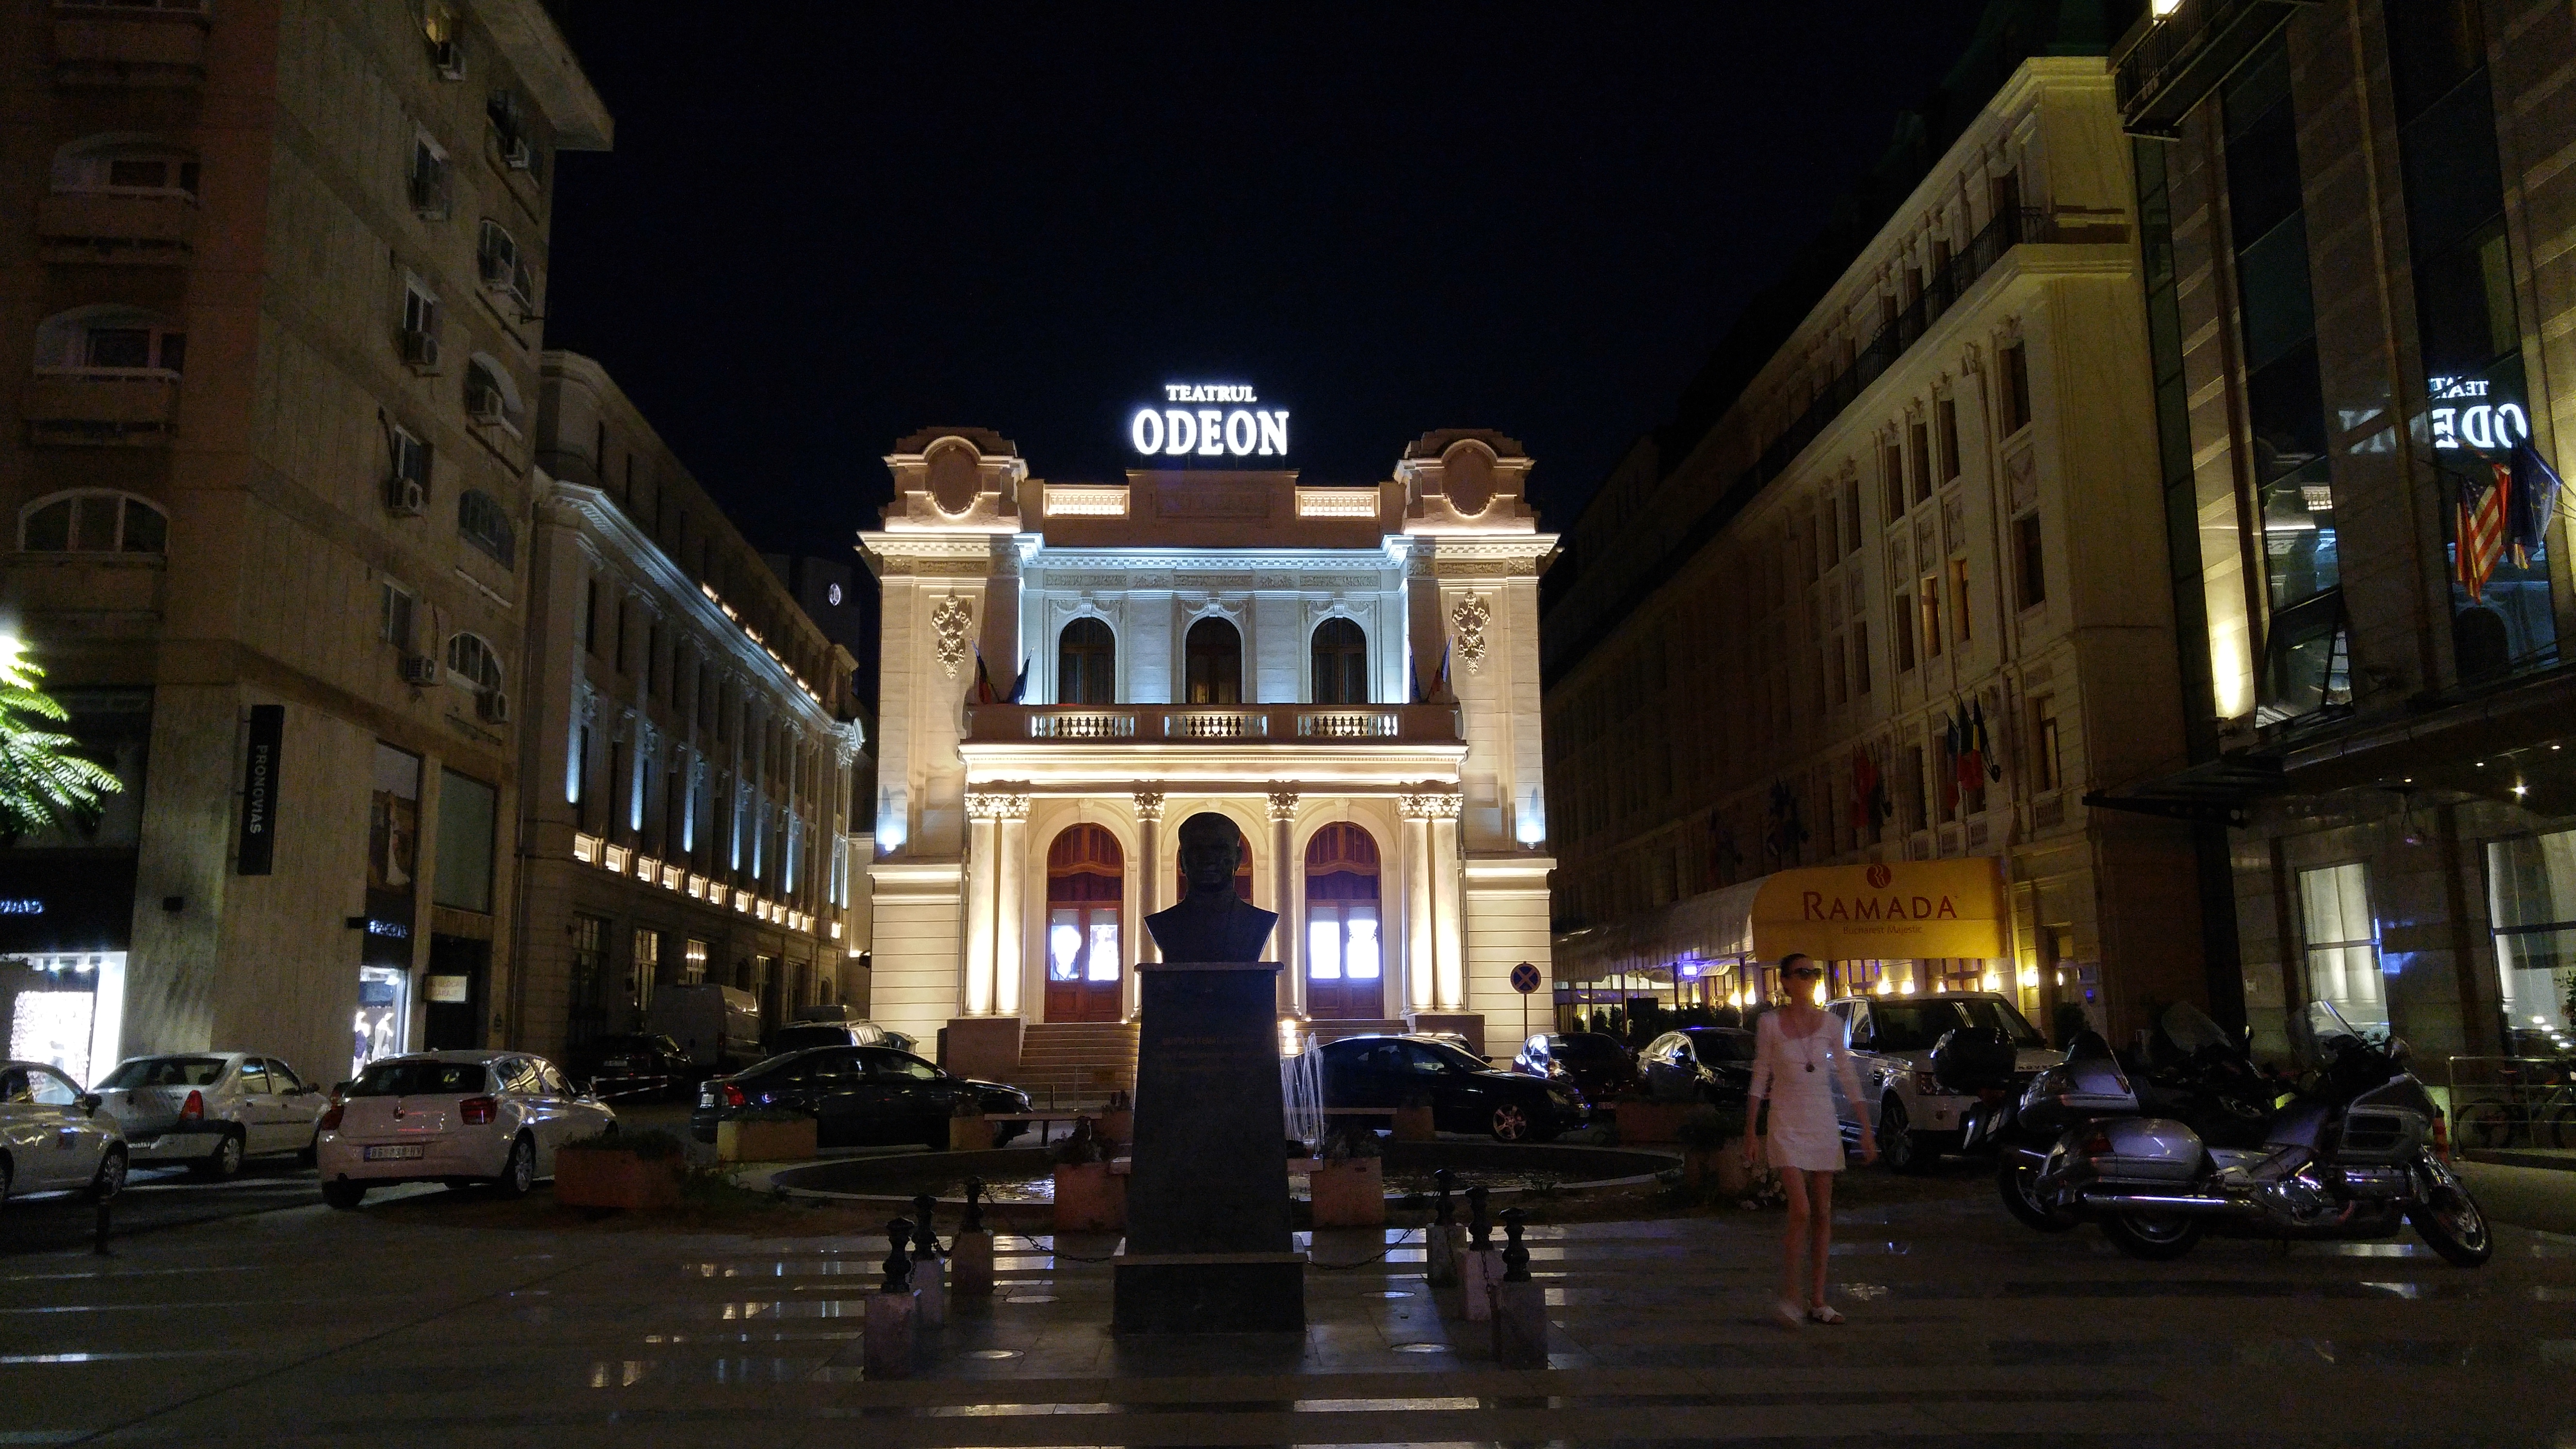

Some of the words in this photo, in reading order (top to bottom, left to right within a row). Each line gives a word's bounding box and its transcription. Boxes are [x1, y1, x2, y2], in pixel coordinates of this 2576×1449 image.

[1166, 385, 1257, 402] TEATRUL
[1132, 409, 1289, 455] ODEON
[249, 744, 269, 834] PRONOVIAS
[1803, 891, 1958, 920] RAMADA
[1843, 926, 1885, 934] Bucharest
[1887, 925, 1922, 934] Majestic
